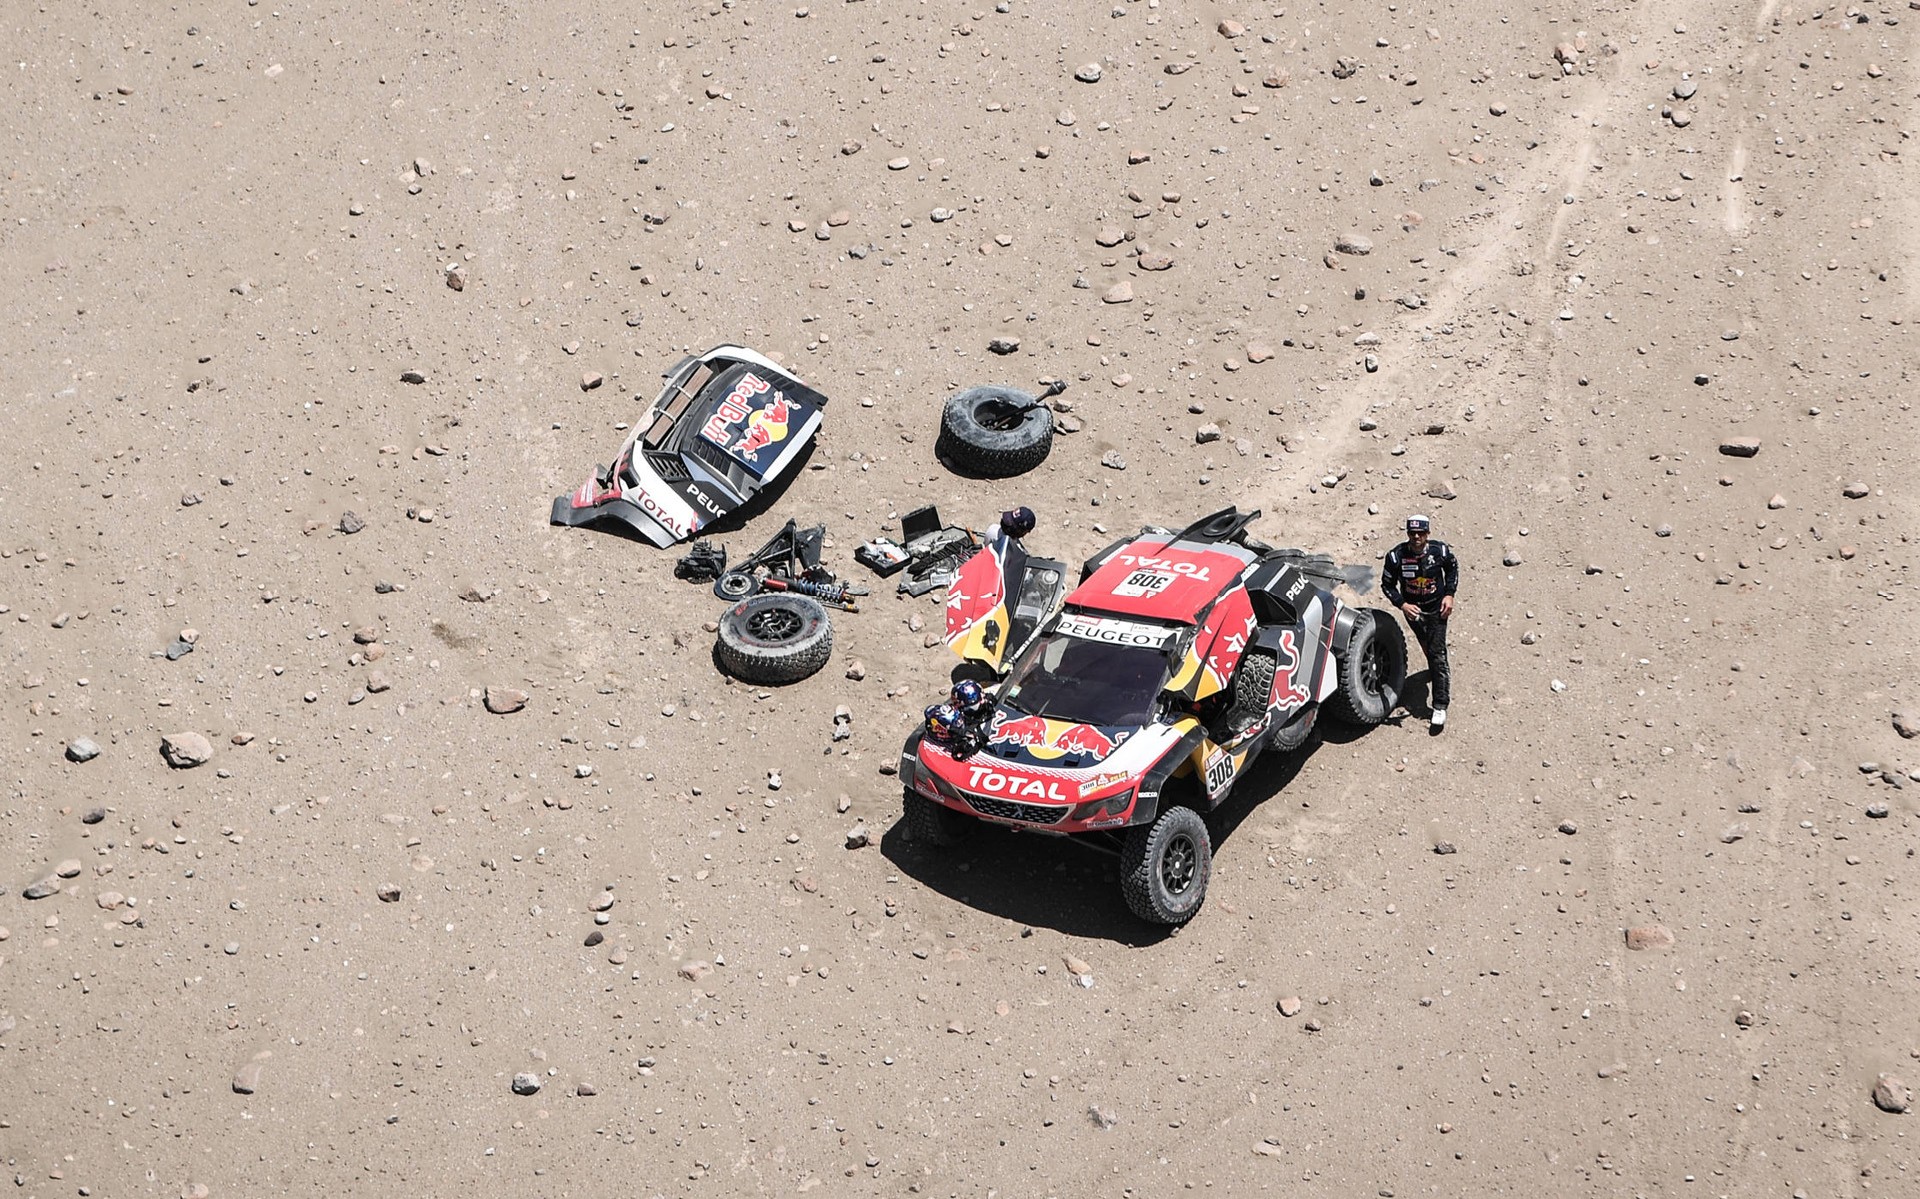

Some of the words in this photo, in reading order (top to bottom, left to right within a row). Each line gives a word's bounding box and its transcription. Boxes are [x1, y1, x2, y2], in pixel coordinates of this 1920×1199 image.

[638, 487, 682, 537] TOTAL
[1119, 555, 1210, 581] TOTAL
[1127, 573, 1169, 590] 308
[1058, 621, 1165, 646] PEUGEOT
[968, 766, 1066, 801] TOTAL
[1209, 755, 1233, 792] 308
